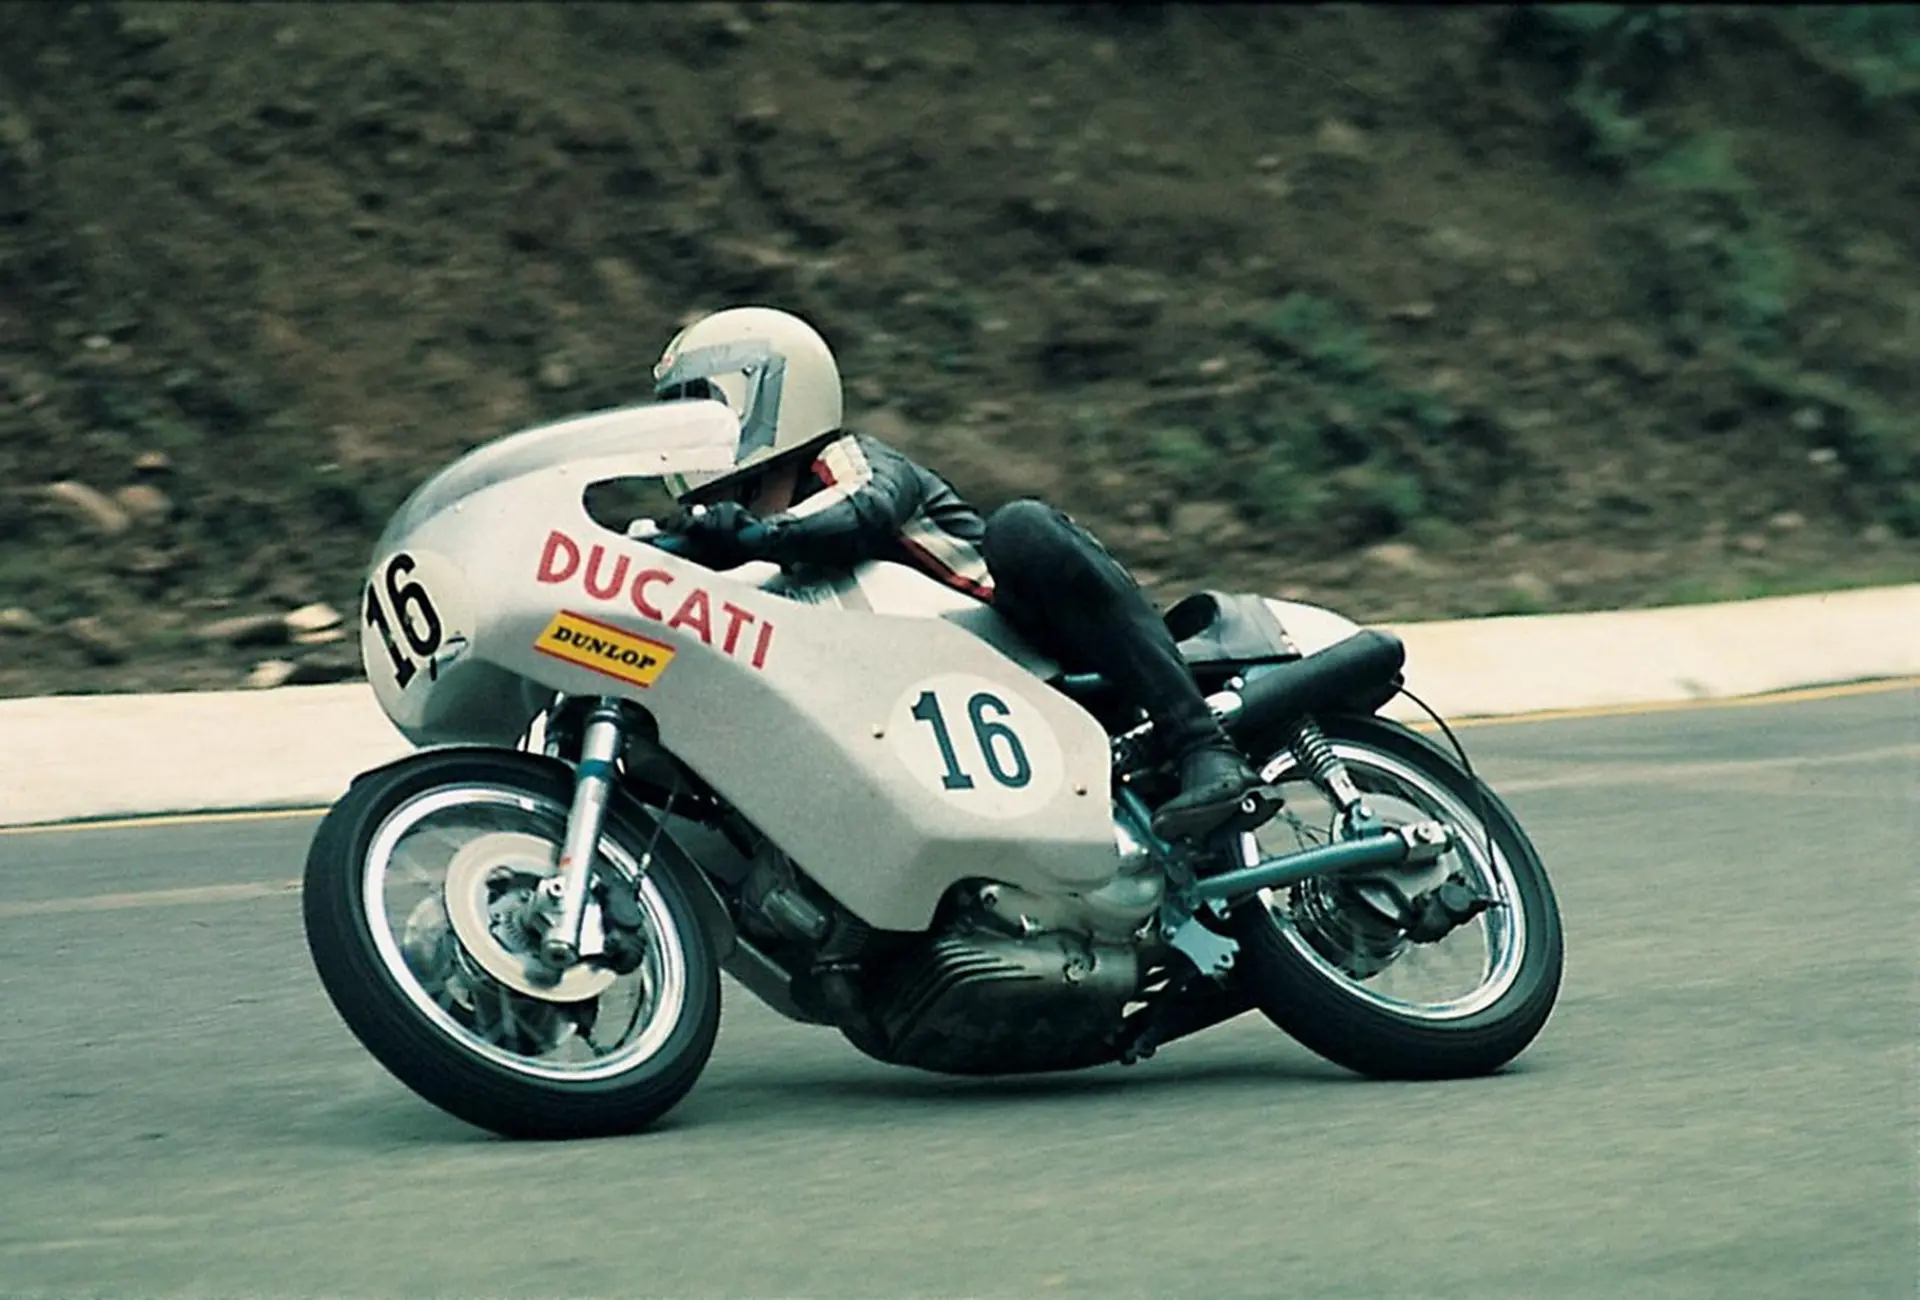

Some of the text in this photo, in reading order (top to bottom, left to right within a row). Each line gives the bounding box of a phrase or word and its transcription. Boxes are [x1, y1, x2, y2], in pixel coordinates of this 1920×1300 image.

[366, 553, 443, 689] 16
[536, 530, 775, 670] DUCATI
[551, 625, 657, 671] DUNLOP
[910, 691, 1032, 790] 16
